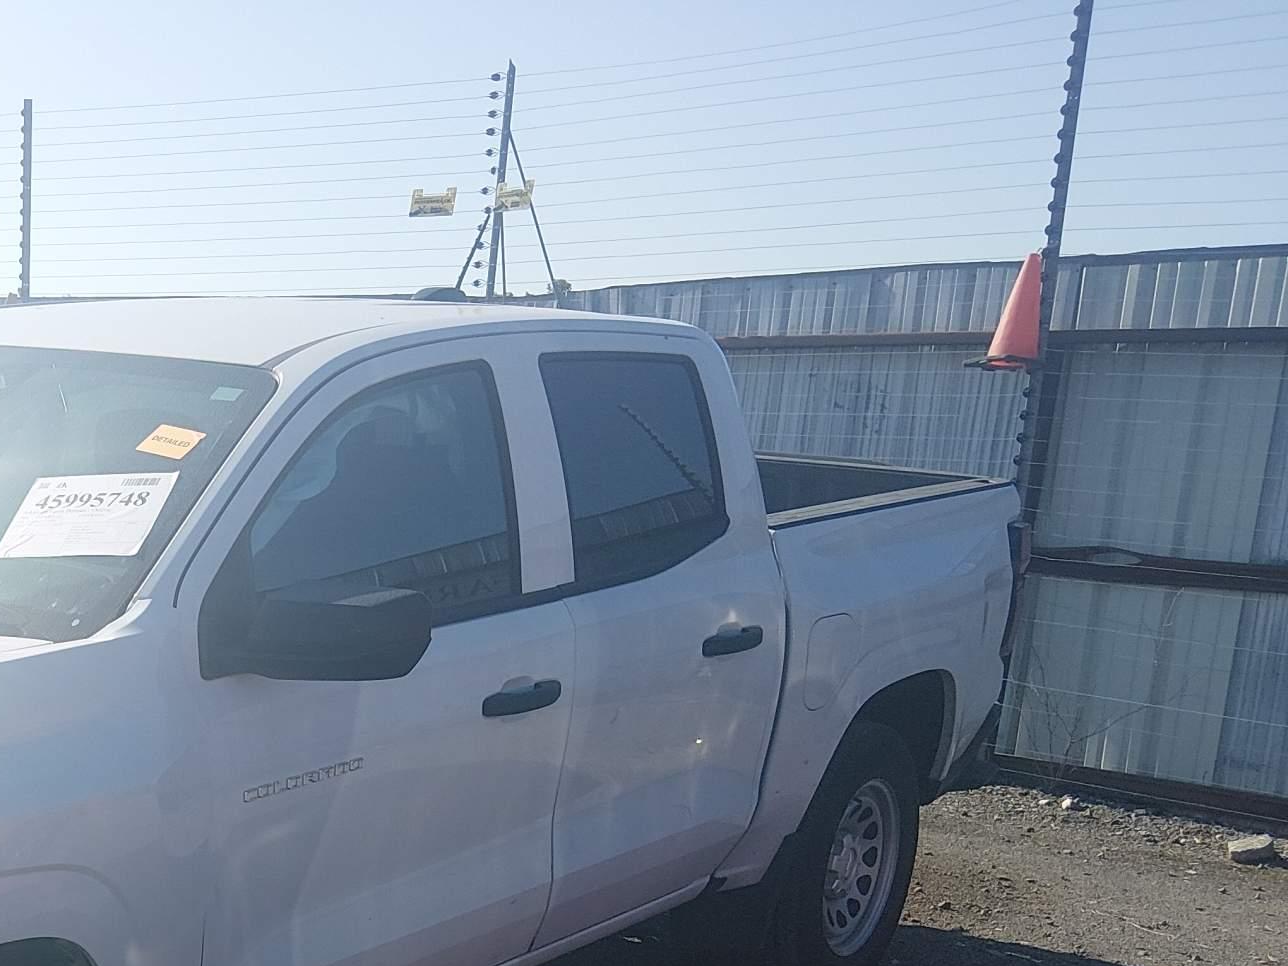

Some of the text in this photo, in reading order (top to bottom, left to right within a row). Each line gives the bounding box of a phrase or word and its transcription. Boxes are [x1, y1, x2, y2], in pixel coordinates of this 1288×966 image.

[151, 435, 191, 448] DETAILED
[35, 491, 150, 509] 45995748
[243, 757, 364, 803] COLORADO
